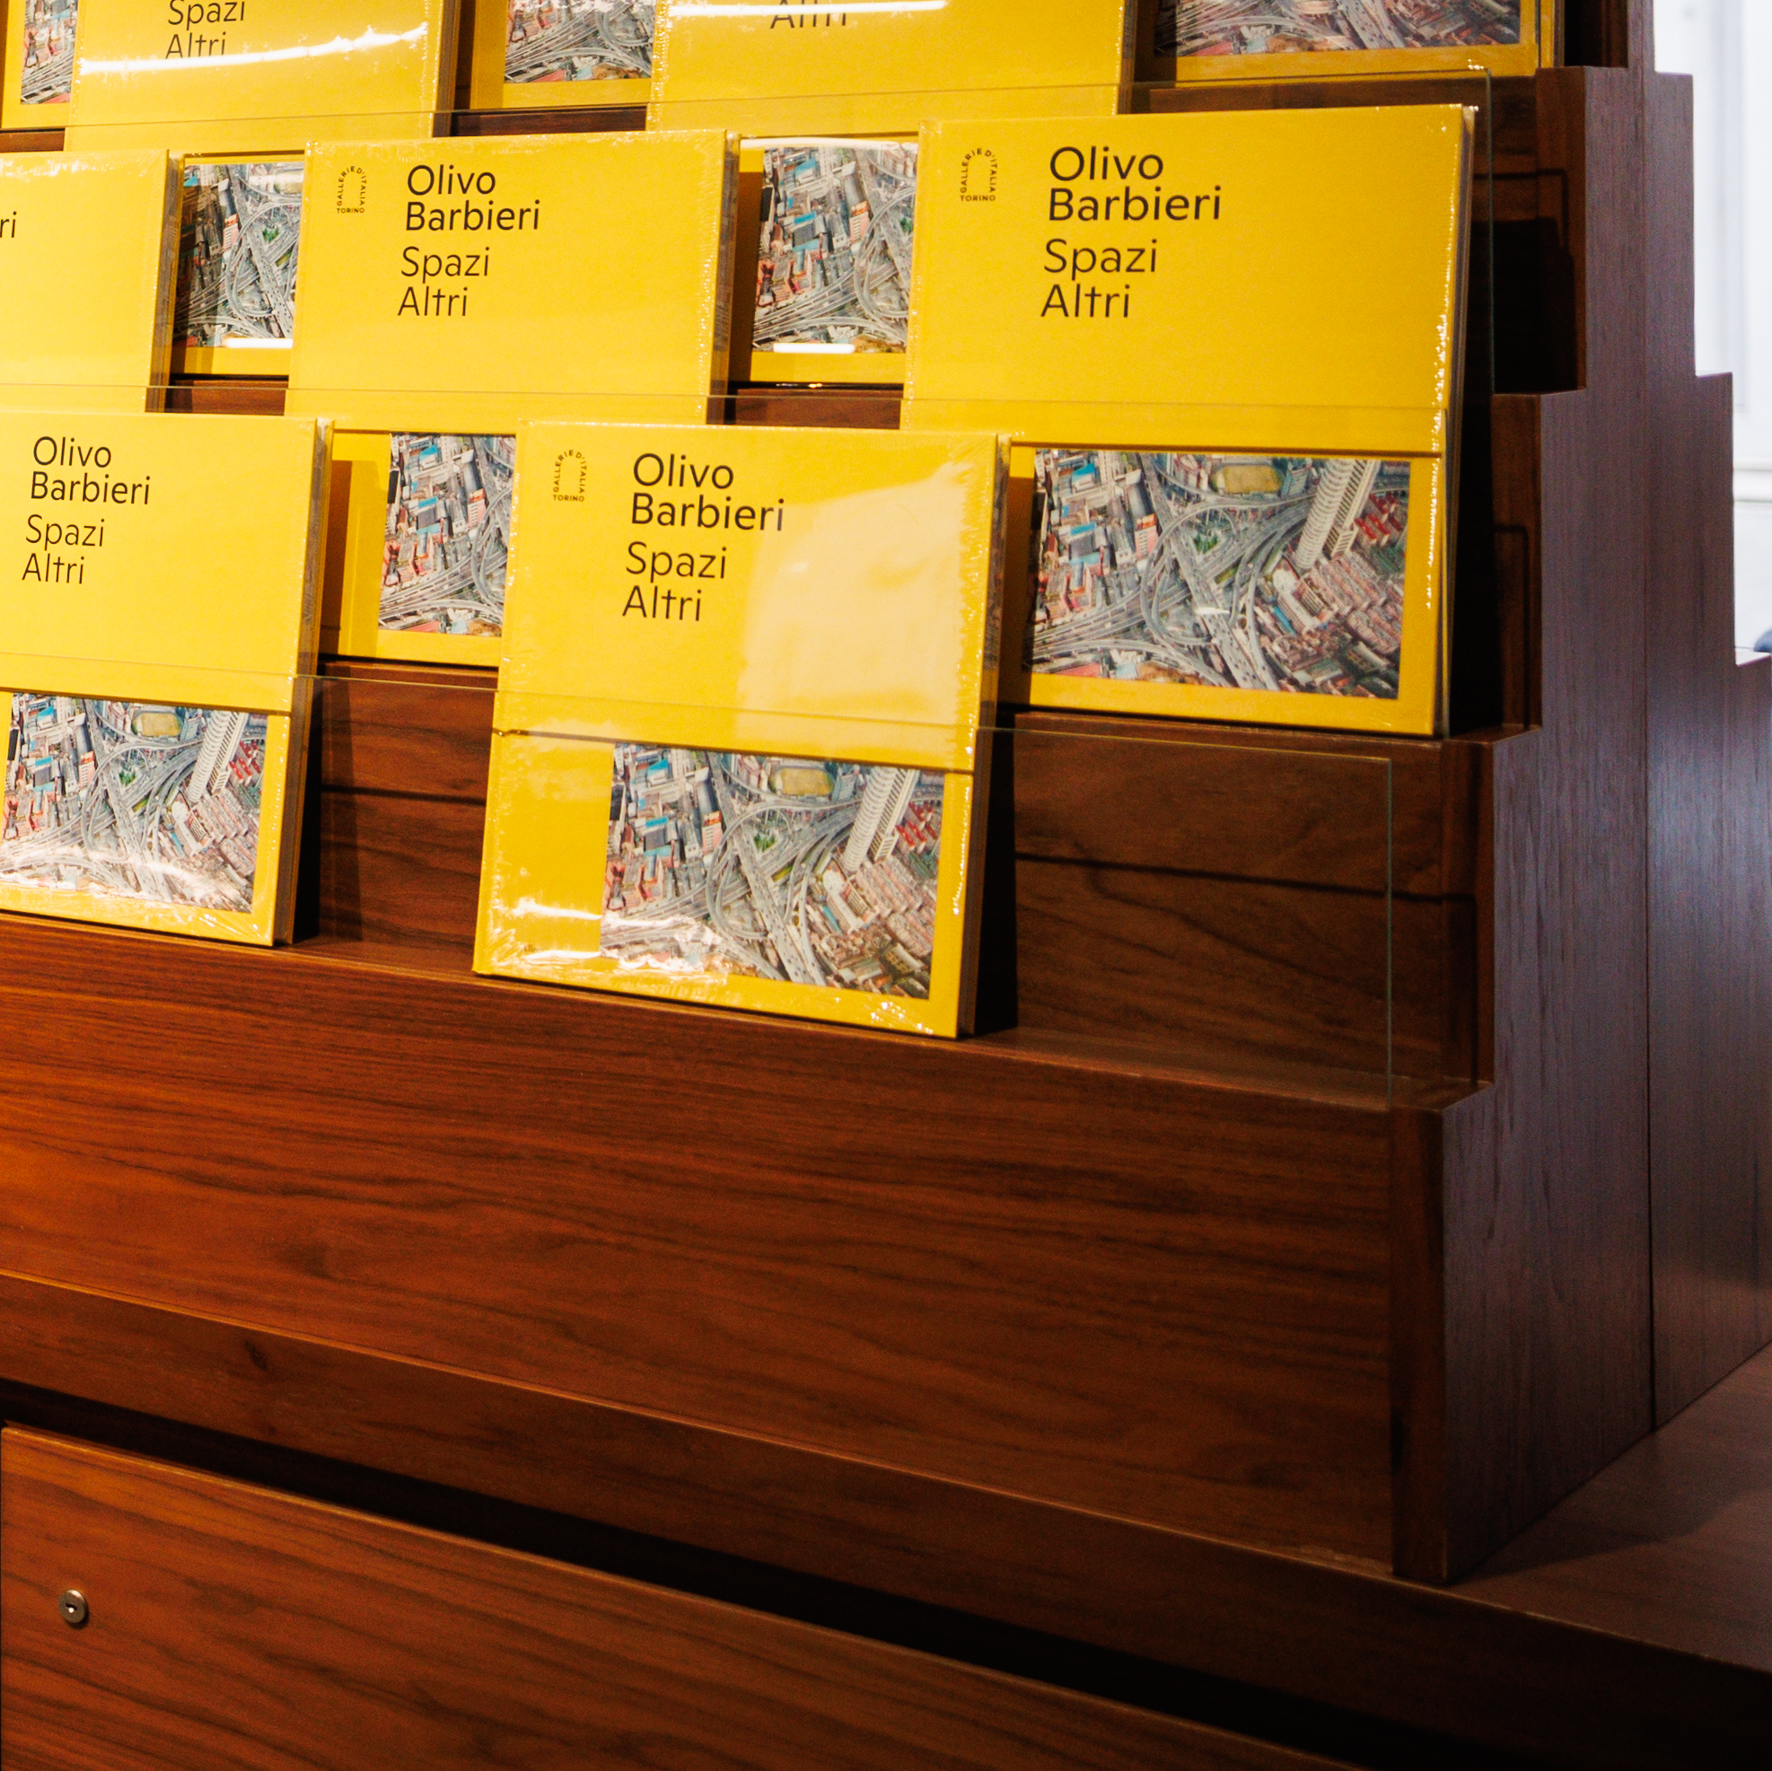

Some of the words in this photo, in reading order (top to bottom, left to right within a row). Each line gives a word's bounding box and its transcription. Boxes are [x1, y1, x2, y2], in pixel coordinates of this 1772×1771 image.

[165, 32, 226, 59] Altri
[407, 163, 496, 197] Olivo
[960, 148, 982, 193] GALLERIE
[1049, 145, 1164, 182] Olivo
[337, 166, 354, 206] GALLERIE
[1048, 184, 1222, 222] Barbieri
[405, 199, 541, 232] Barbieri
[400, 245, 489, 285] Spazi
[1043, 237, 1158, 282] Spazi
[397, 285, 468, 317] Altri
[1040, 282, 1131, 319] Altri
[33, 435, 112, 469] Olivo
[553, 449, 573, 492] GALLERIE
[633, 452, 734, 490] Olivo
[30, 470, 151, 505] Barbieri
[631, 492, 785, 532] Barbieri
[25, 513, 104, 552] Spazi
[21, 552, 84, 585] Altri
[625, 540, 727, 584] Spazi
[621, 584, 701, 622] Altri
